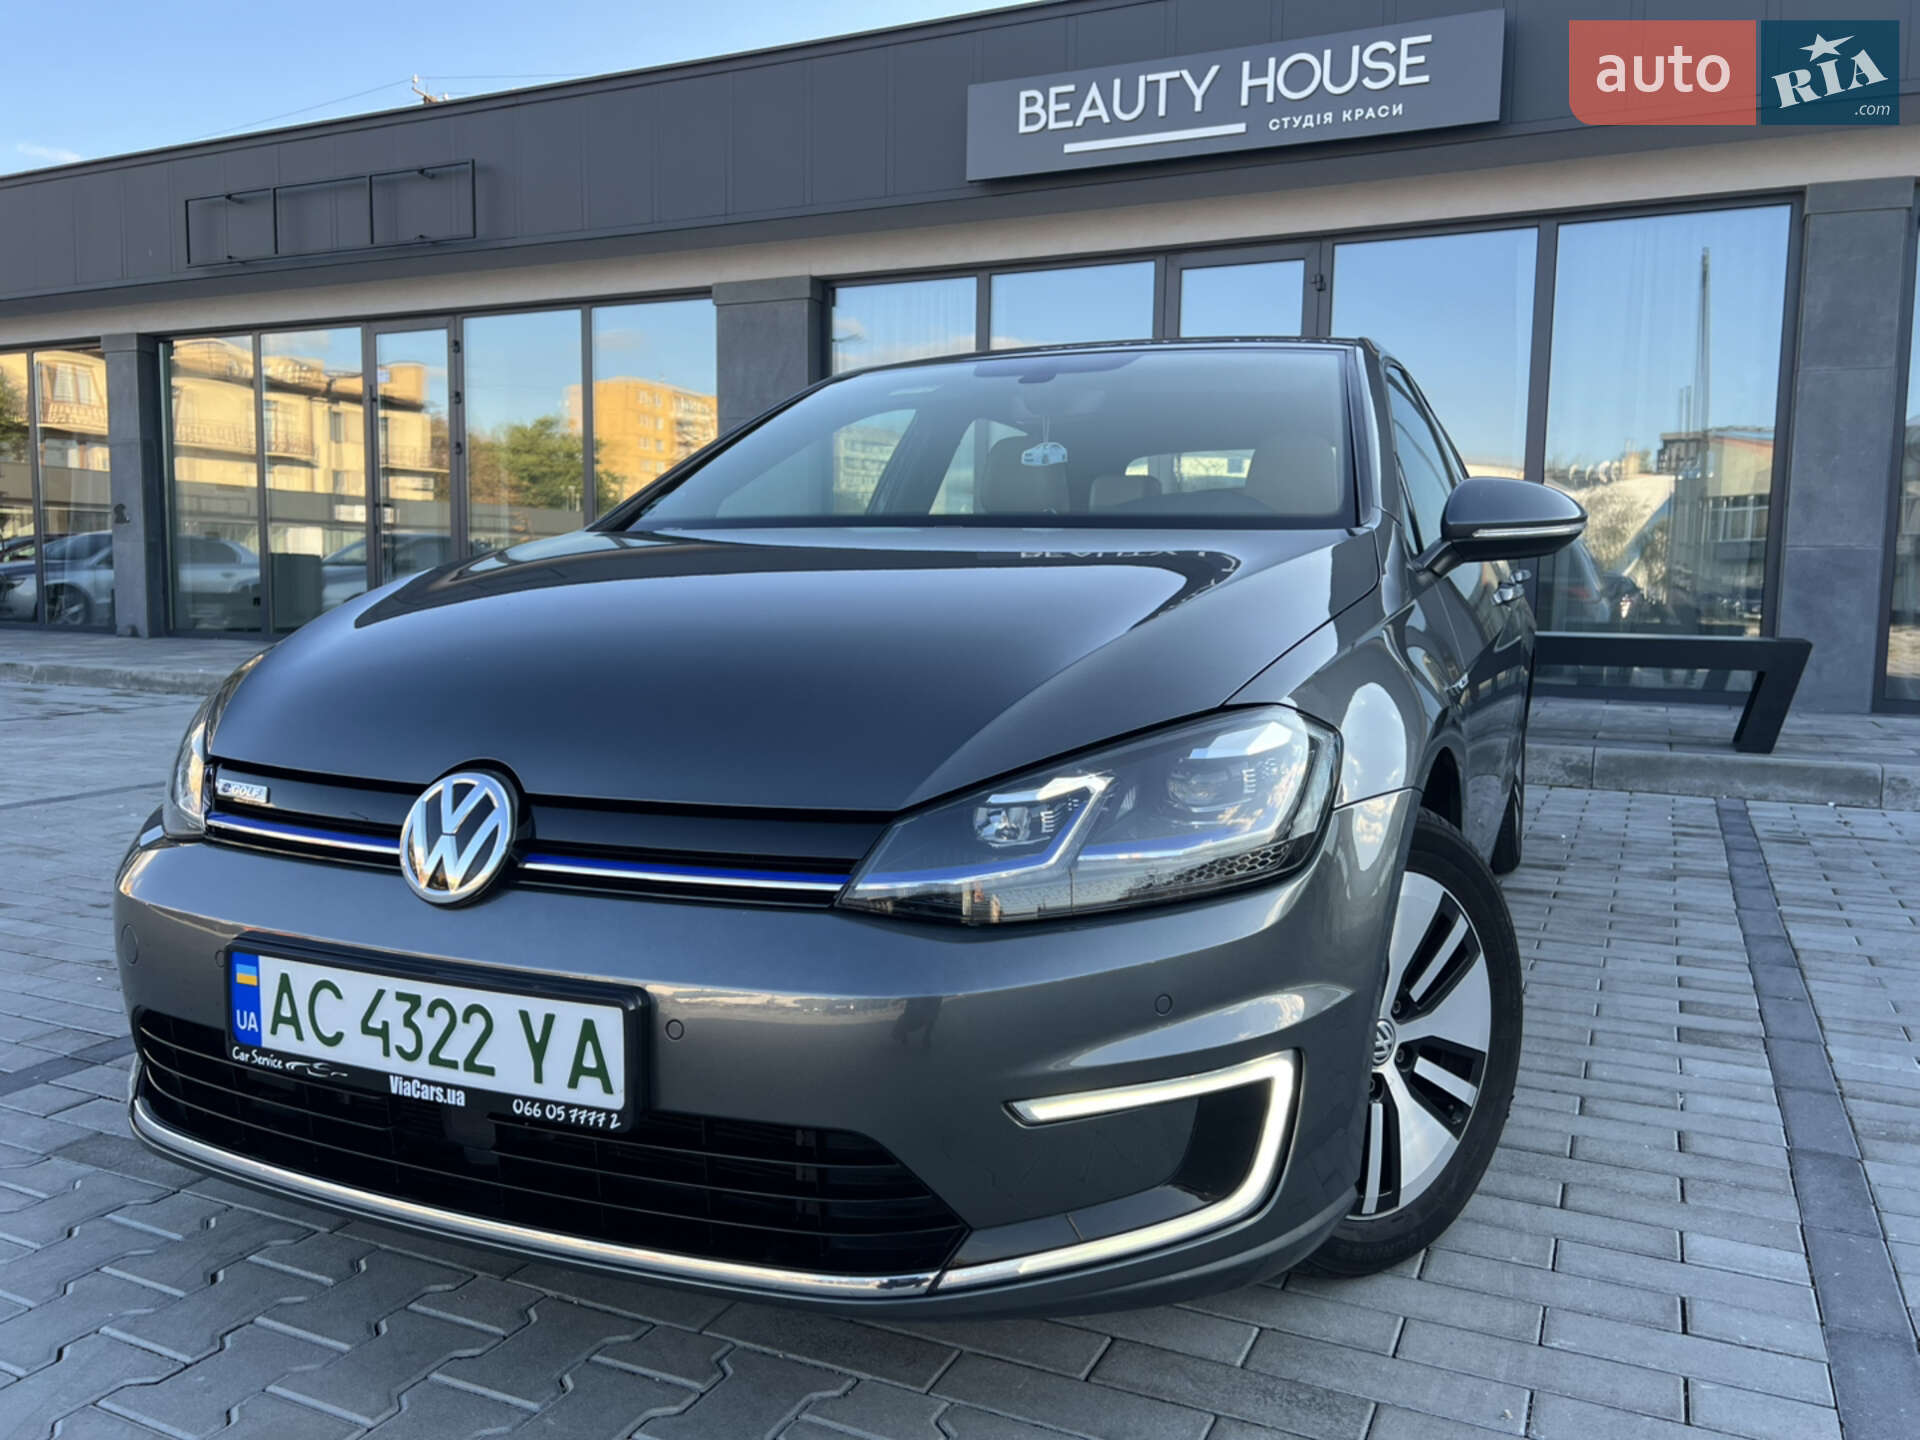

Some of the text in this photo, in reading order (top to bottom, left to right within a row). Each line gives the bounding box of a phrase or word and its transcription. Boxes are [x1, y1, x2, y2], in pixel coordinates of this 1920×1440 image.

[1018, 33, 1433, 134] BEAUTY HOUSE
[1268, 103, 1403, 131] СТУДІЯ КРАСИ
[236, 1008, 259, 1033] UA
[269, 972, 615, 1096] AC 4322 YA
[231, 1045, 284, 1071] Car Service
[388, 1074, 466, 1107] ViaCars.ua
[512, 1098, 542, 1118] 066
[545, 1103, 566, 1121] 05
